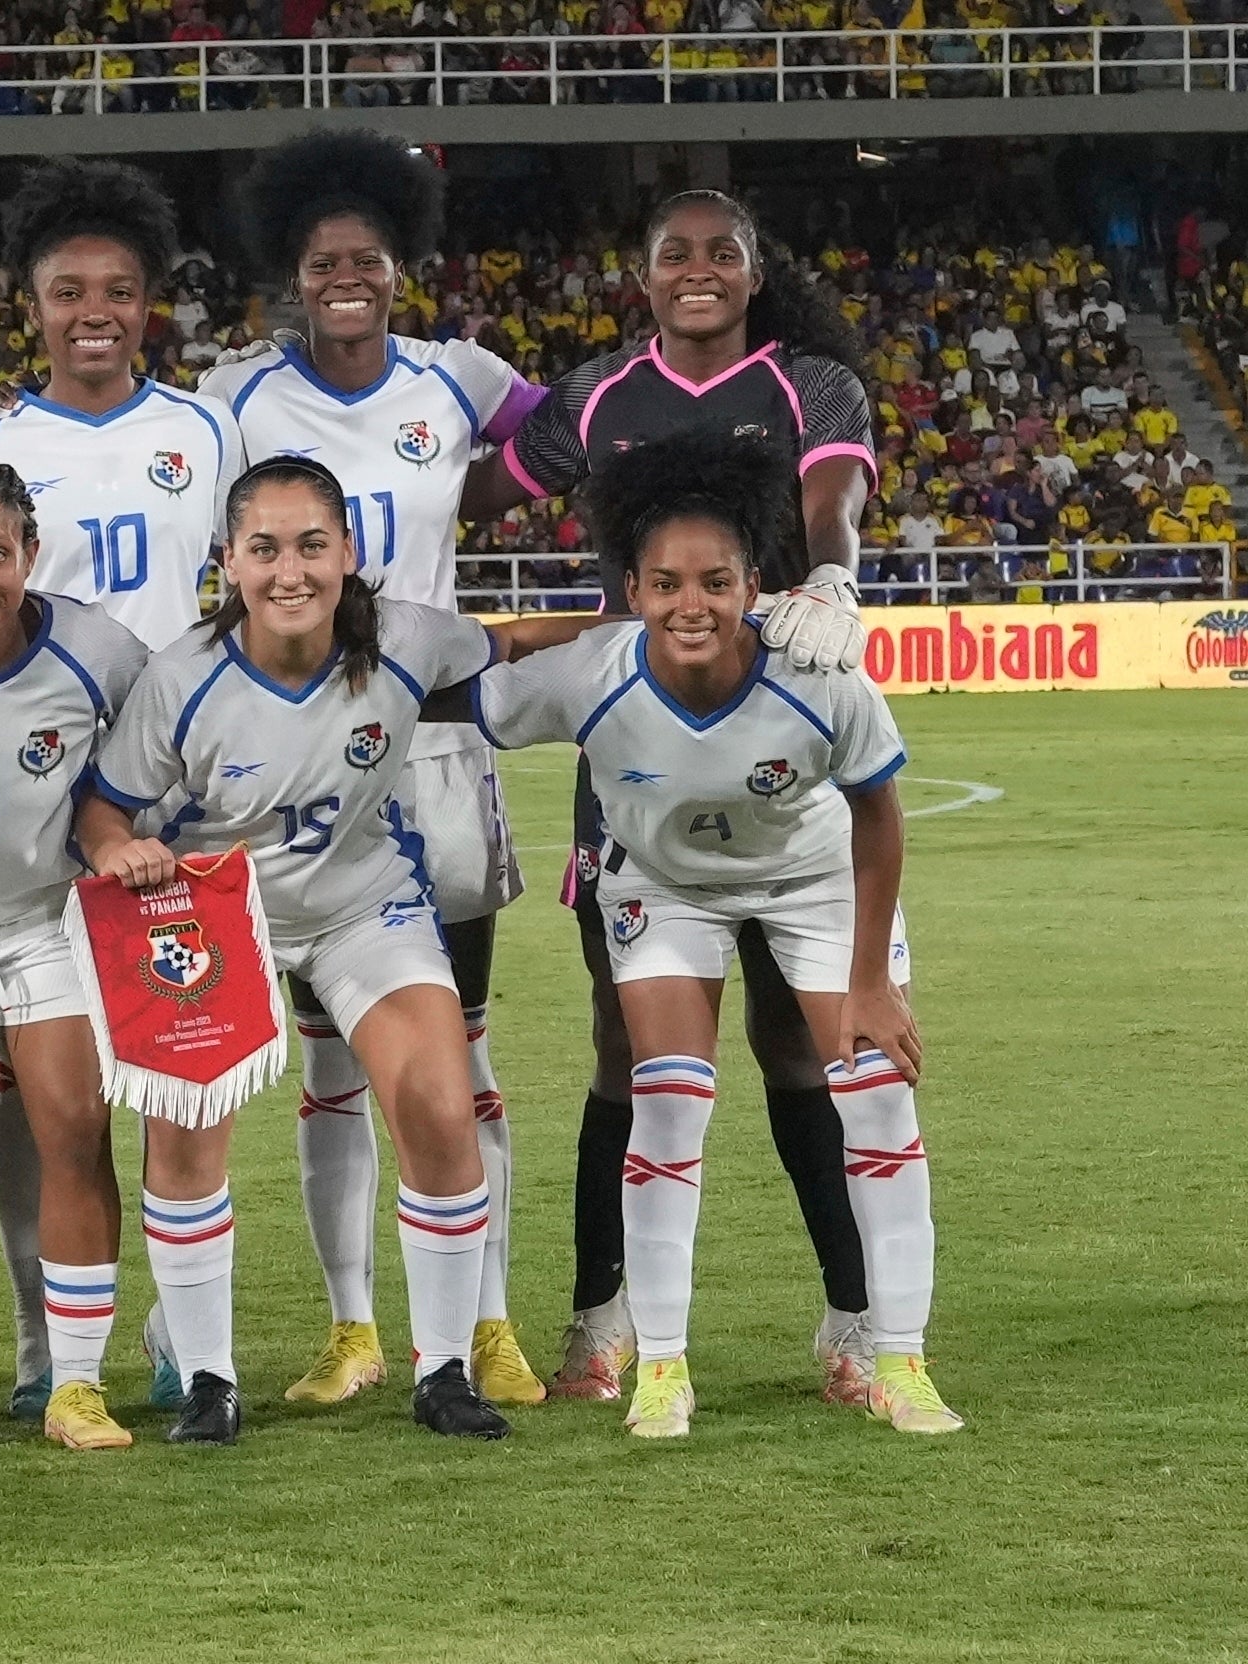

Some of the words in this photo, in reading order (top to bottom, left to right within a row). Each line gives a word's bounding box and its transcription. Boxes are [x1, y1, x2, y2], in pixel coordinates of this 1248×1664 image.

[77, 512, 150, 593] 10
[344, 490, 395, 572] 11
[272, 796, 340, 854] 15
[689, 812, 732, 841] 4
[139, 880, 191, 902] COLOMBIA
